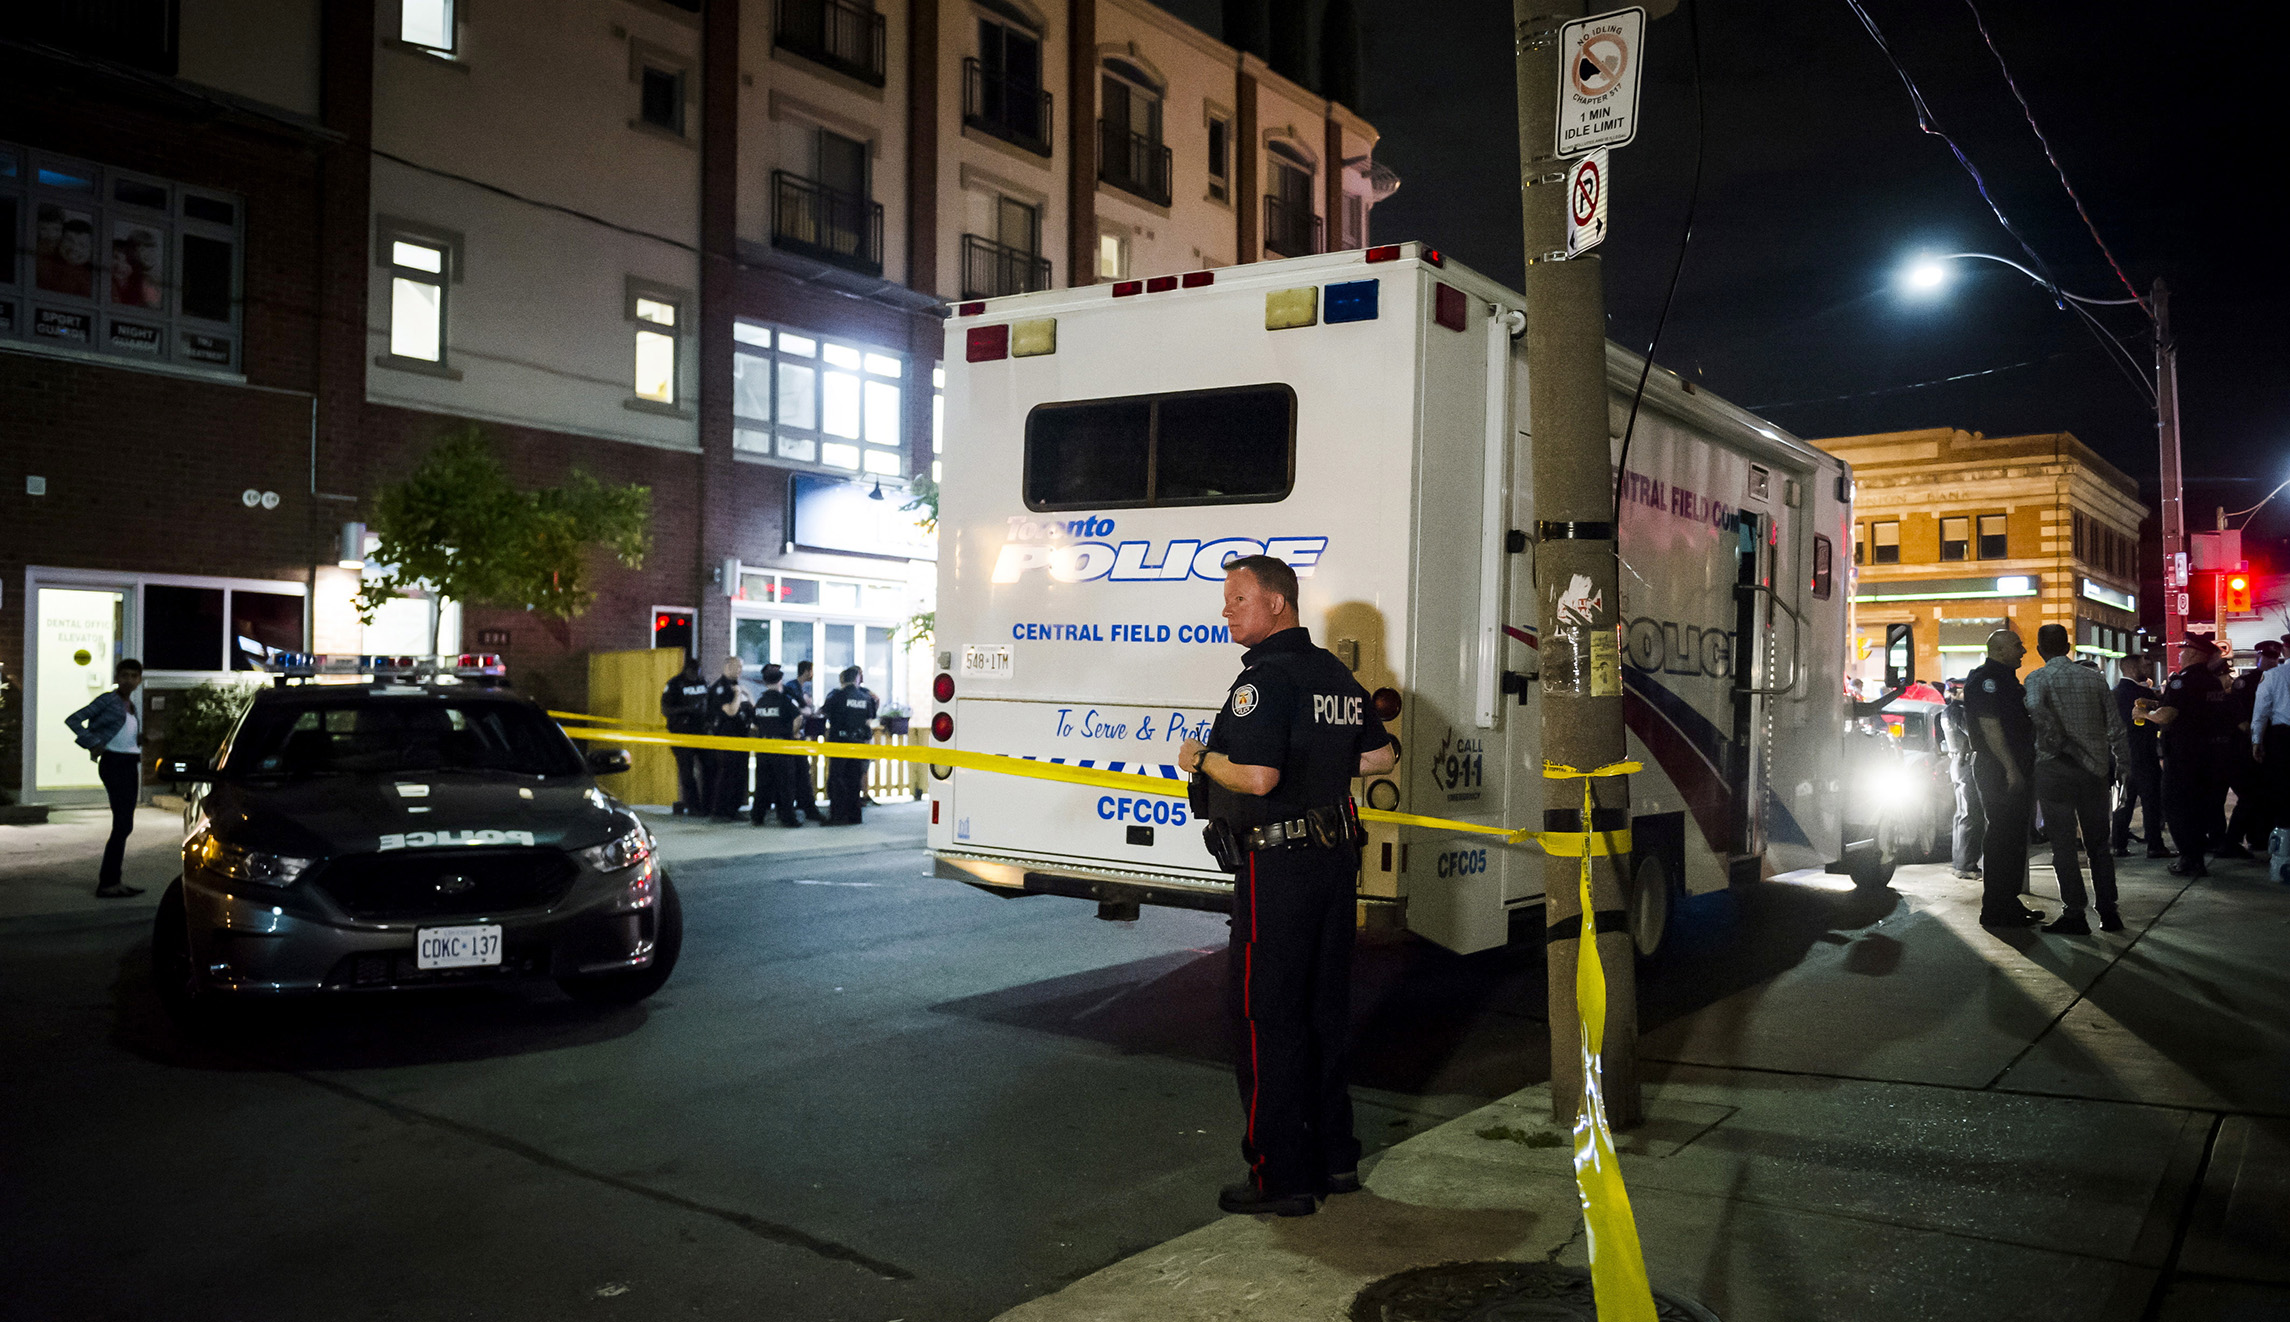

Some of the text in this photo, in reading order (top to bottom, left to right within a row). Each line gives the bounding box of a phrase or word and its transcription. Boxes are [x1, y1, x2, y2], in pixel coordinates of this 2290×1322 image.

[1577, 25, 1623, 47] NO IDLING
[1572, 82, 1622, 105] CHAPTER 517
[1580, 106, 1611, 123] 1 MIN
[1564, 117, 1625, 141] IDLE LIMIT
[42, 311, 82, 328] SPORT
[117, 325, 155, 340] NIGHT
[1672, 486, 1708, 524] FIELD
[1712, 501, 1740, 533] COM
[1006, 514, 1115, 543] Toronto
[991, 536, 1329, 584] POLICE
[46, 618, 82, 629] DENTAL
[1012, 623, 1229, 643] CENTRAL FIELD COM
[58, 632, 105, 643] ELEVATOR
[1621, 616, 1736, 679] OLIC
[682, 684, 708, 696] POLICE
[755, 706, 781, 718] POLICE
[846, 699, 868, 710] POLICE
[1313, 694, 1364, 726] POLICE
[1056, 709, 1211, 745] To Serve & Prote
[1457, 738, 1483, 753] CALL
[1097, 796, 1188, 826] CFC05
[1438, 848, 1487, 878] CFC05
[422, 935, 499, 959] CDKC 137
